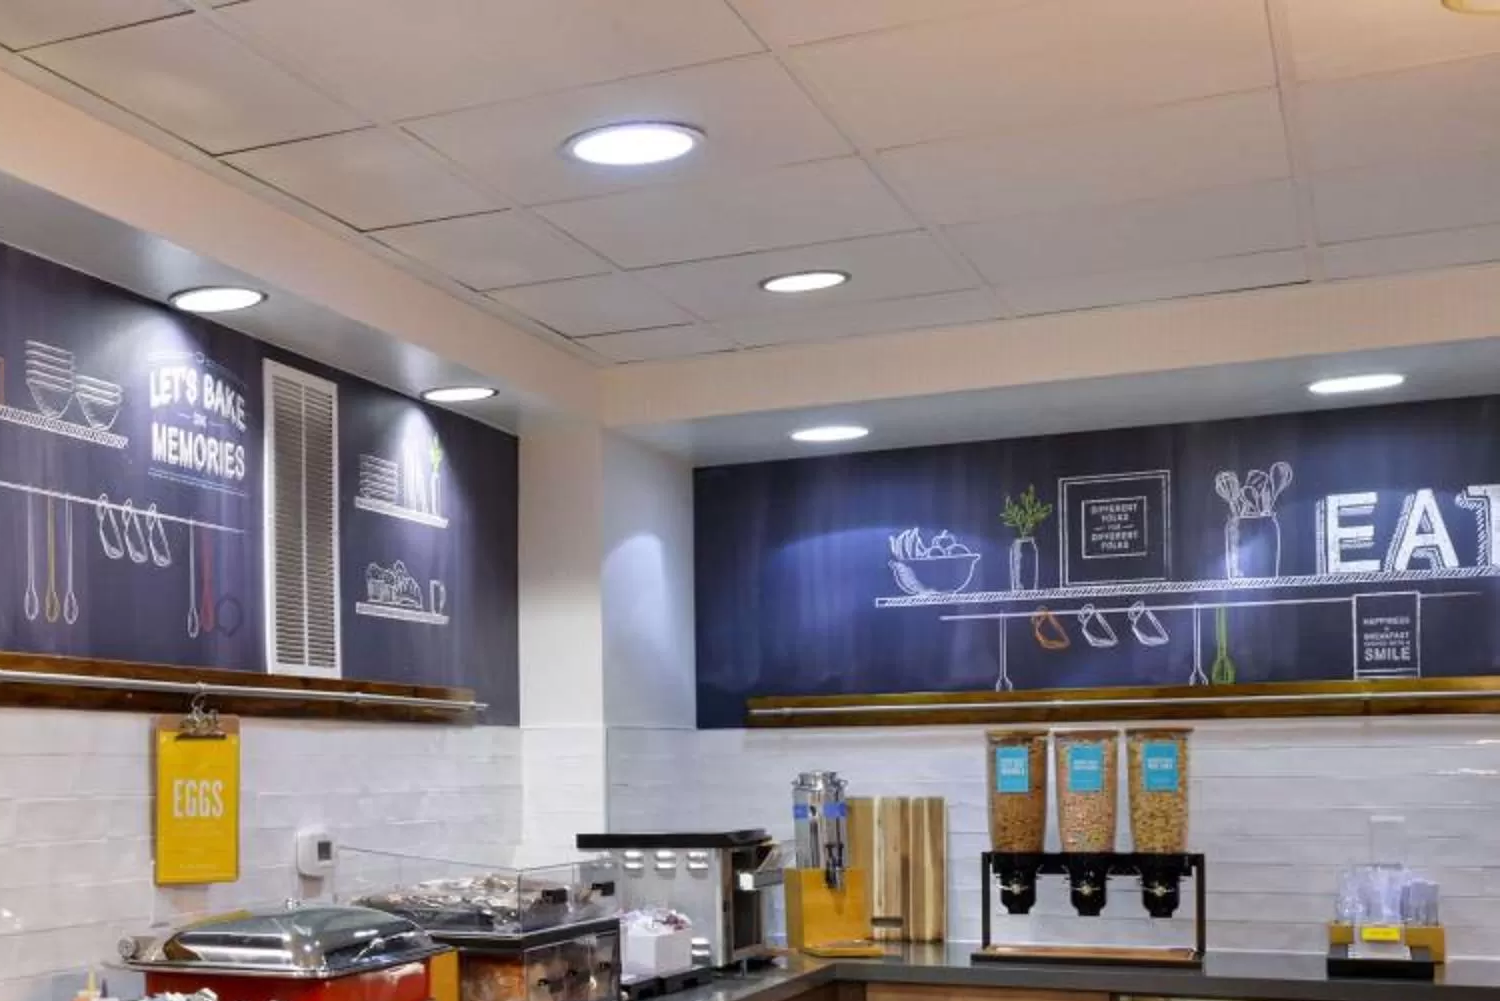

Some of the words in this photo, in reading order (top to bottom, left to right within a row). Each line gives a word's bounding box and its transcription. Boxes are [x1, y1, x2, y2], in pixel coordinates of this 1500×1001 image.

[149, 365, 198, 408] LET'S
[203, 372, 247, 432] BAKE
[151, 421, 245, 481] MEMORIES
[1364, 647, 1411, 662] SMILE
[173, 778, 225, 818] EGGS
